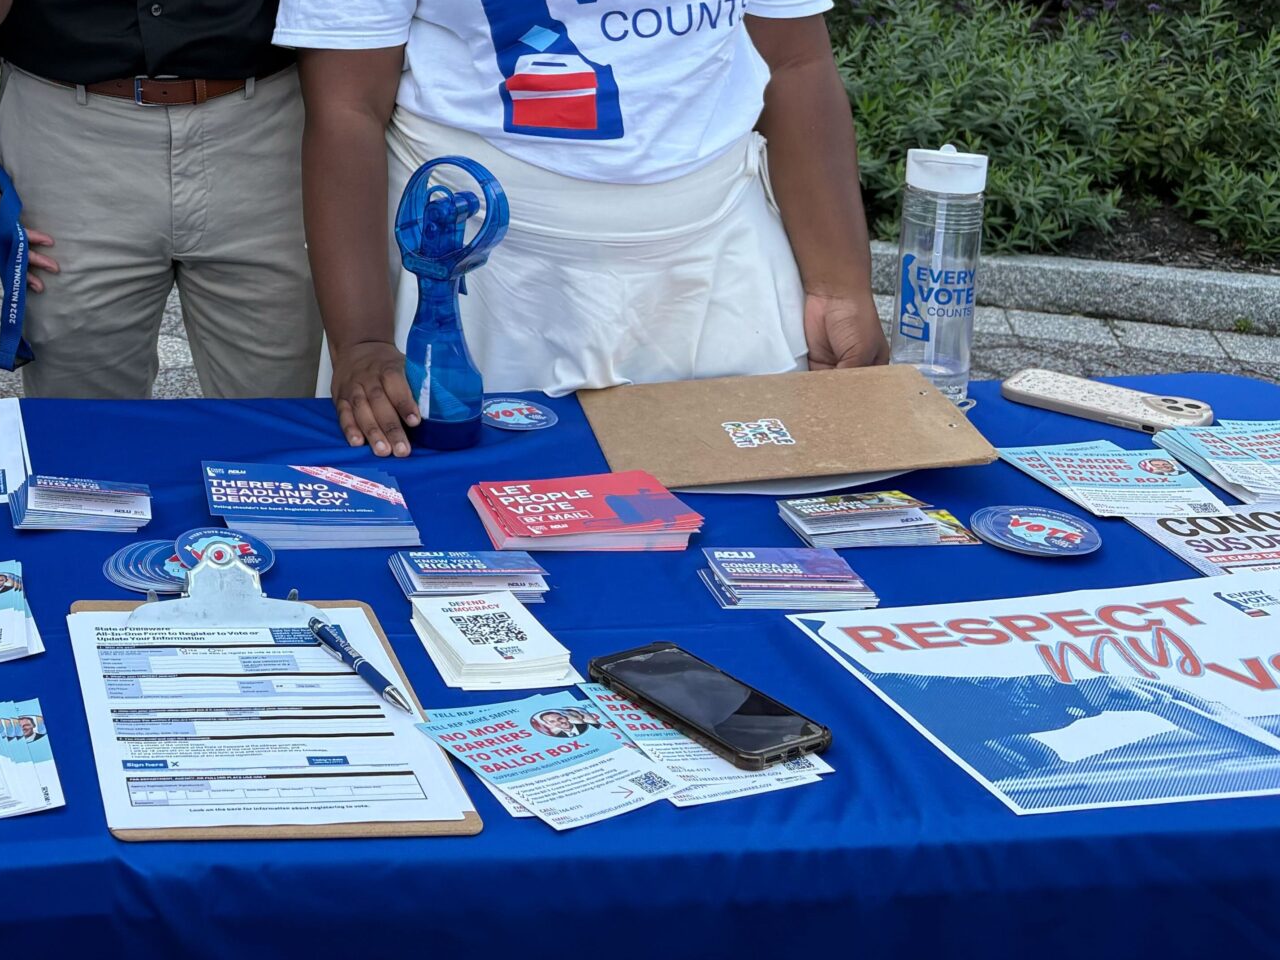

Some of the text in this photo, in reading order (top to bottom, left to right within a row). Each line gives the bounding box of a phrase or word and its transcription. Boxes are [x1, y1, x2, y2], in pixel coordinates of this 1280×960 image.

[15, 243, 24, 264] LIVED
[11, 264, 21, 302] NATIONAL
[917, 267, 976, 284] EVERY
[917, 285, 974, 305] VOTE
[9, 303, 17, 324] 2024
[485, 407, 543, 421] VOTE
[209, 479, 302, 489] THERE'S
[489, 484, 530, 496] LET
[211, 487, 348, 499] DEADLINE ON
[213, 494, 349, 506] DEMOCRACY.
[499, 489, 593, 505] PEOPLE
[507, 502, 575, 515] VOTE
[523, 512, 589, 523] BY MAIL
[1010, 516, 1085, 544] VOTE
[1185, 537, 1252, 553] SUS
[1226, 590, 1264, 599] EVERY
[1237, 596, 1277, 605] VOTE
[442, 604, 501, 613] DEMOCRACY
[838, 597, 1207, 654] RESPECT
[438, 720, 519, 743] NO MORE
[451, 730, 533, 753] BARRIERS
[465, 744, 526, 763] TO THE
[480, 741, 591, 774] BALLOT BOX.
